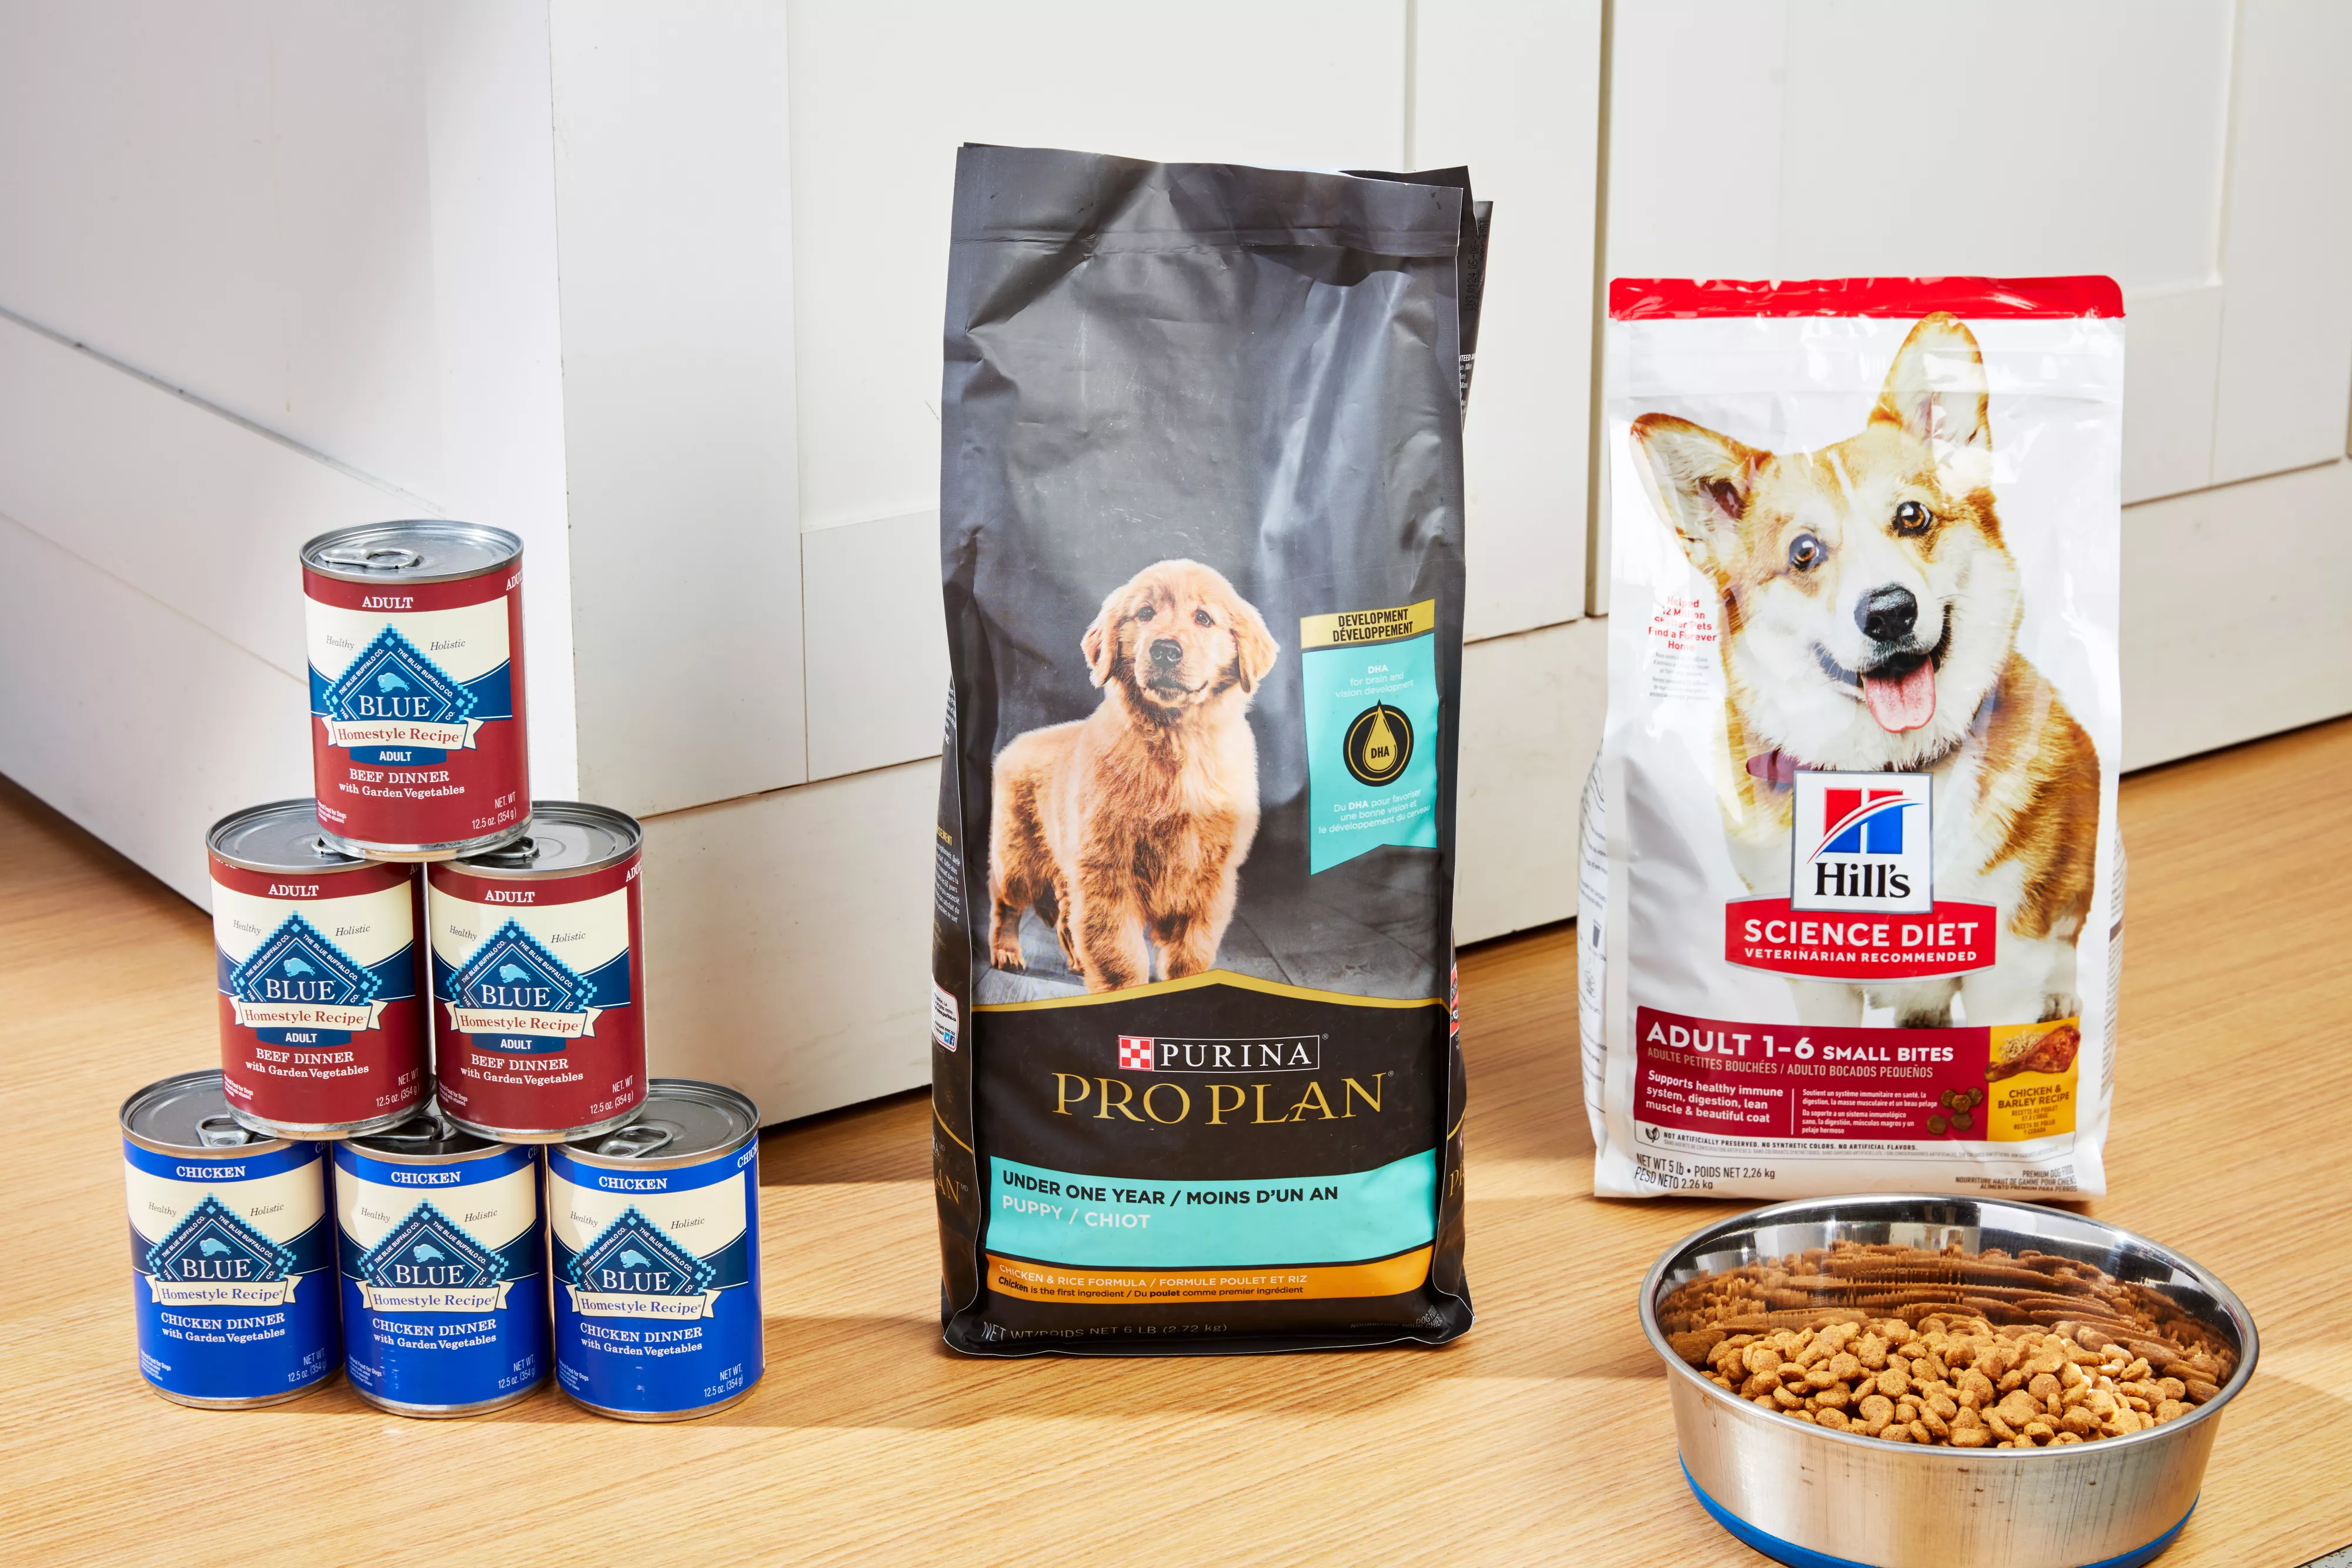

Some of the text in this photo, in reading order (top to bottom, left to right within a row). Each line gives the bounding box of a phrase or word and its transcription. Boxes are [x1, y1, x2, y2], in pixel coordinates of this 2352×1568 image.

[362, 596, 413, 609] ADULT
[1338, 609, 1408, 627] DEVELOPMENT
[1333, 621, 1413, 642] DÉVELOPPEMENT
[326, 636, 355, 650] Healthy
[430, 639, 466, 651] Holistic
[338, 648, 385, 695] THE BLUE BUFFALO CO.
[1368, 664, 1388, 673] DHA
[407, 657, 422, 671] BLUE
[421, 670, 445, 691] BUFFALO
[443, 687, 453, 698] CO.
[1366, 676, 1388, 684] brain
[1390, 672, 1404, 680] and
[1335, 680, 1414, 697] vision development
[359, 695, 430, 717] BLUE
[338, 728, 406, 741] Homestyle
[1371, 746, 1389, 758] DHA
[349, 768, 449, 783] BEEF DINNER
[339, 783, 465, 800] with Garden Vegetables
[495, 791, 515, 808] NET. WT
[472, 818, 486, 829] 12.5
[497, 810, 509, 825] (354
[268, 885, 319, 897] ADULT
[485, 890, 535, 903] ADULT
[1744, 919, 1978, 947] SCIENCE DIET
[1745, 948, 1977, 963] VETERINARIAN RECOMMENDED
[266, 979, 336, 1000] BLUE
[480, 985, 550, 1007] BLUE
[245, 1009, 311, 1022] Homestyle
[460, 1015, 526, 1029] Homestyle
[1646, 1022, 1751, 1056] ADULT
[1823, 1047, 1890, 1061] SMALL
[1897, 1047, 1953, 1061] BITES
[256, 1048, 354, 1064] BEEF DINNER
[471, 1054, 568, 1071] BEEF DINNER
[1161, 1043, 1312, 1067] PURINA
[1648, 1047, 1777, 1074] ADULTE PETITES BOUCHÉES
[1788, 1064, 1933, 1078] ADULTO BOCADOS PEQUEÑOS
[1649, 1070, 1783, 1096] Supports healthy immune
[1052, 1073, 1387, 1124] PRO PLAN
[1646, 1087, 1768, 1109] system, digestion, lean
[1998, 1092, 2069, 1109] BARLEY RECIPE
[2009, 1086, 2052, 1098] CHICKEN
[1646, 1101, 1770, 1123] muscle & beautiful coat
[1678, 1134, 1719, 1145] ARTIFICIALLY
[176, 1166, 246, 1178] CHICKEN
[1637, 1153, 1684, 1175] NET WT 5 lb
[1695, 1165, 1720, 1178] POIDS
[1723, 1167, 1740, 1178] NET
[1765, 1168, 1775, 1179] kg
[391, 1171, 461, 1184] CHICKEN
[599, 1176, 668, 1189] CHICKEN
[1635, 1166, 1713, 1189] PESO NETO 2.26 kg
[1003, 1170, 1165, 1204] UNDER ONE YEAR
[1187, 1191, 1250, 1205] MOINS
[1309, 1186, 1338, 1200] AN
[1002, 1195, 1063, 1219] PUPPY
[1085, 1212, 1151, 1228] CHIOT
[181, 1258, 251, 1279] BLUE
[394, 1265, 465, 1285] BLUE
[1000, 1265, 1043, 1282] CHICKEN
[1058, 1277, 1084, 1285] RICE
[602, 1269, 671, 1291] BLUE
[998, 1276, 1028, 1292] Chicken
[1078, 1289, 1124, 1299] ingredient
[1160, 1278, 1216, 1286] FORMULE
[1221, 1277, 1267, 1285] POULET
[161, 1288, 228, 1302] Homestyle
[1257, 1286, 1303, 1295] ingrédient
[373, 1295, 440, 1307] Homestyle
[581, 1299, 647, 1312] Homestyle
[161, 1312, 285, 1330] CHICKEN DINNER
[372, 1318, 497, 1336] CHICKEN DINNER
[580, 1323, 703, 1342] CHICKEN DINNER
[981, 1322, 1006, 1342] NET
